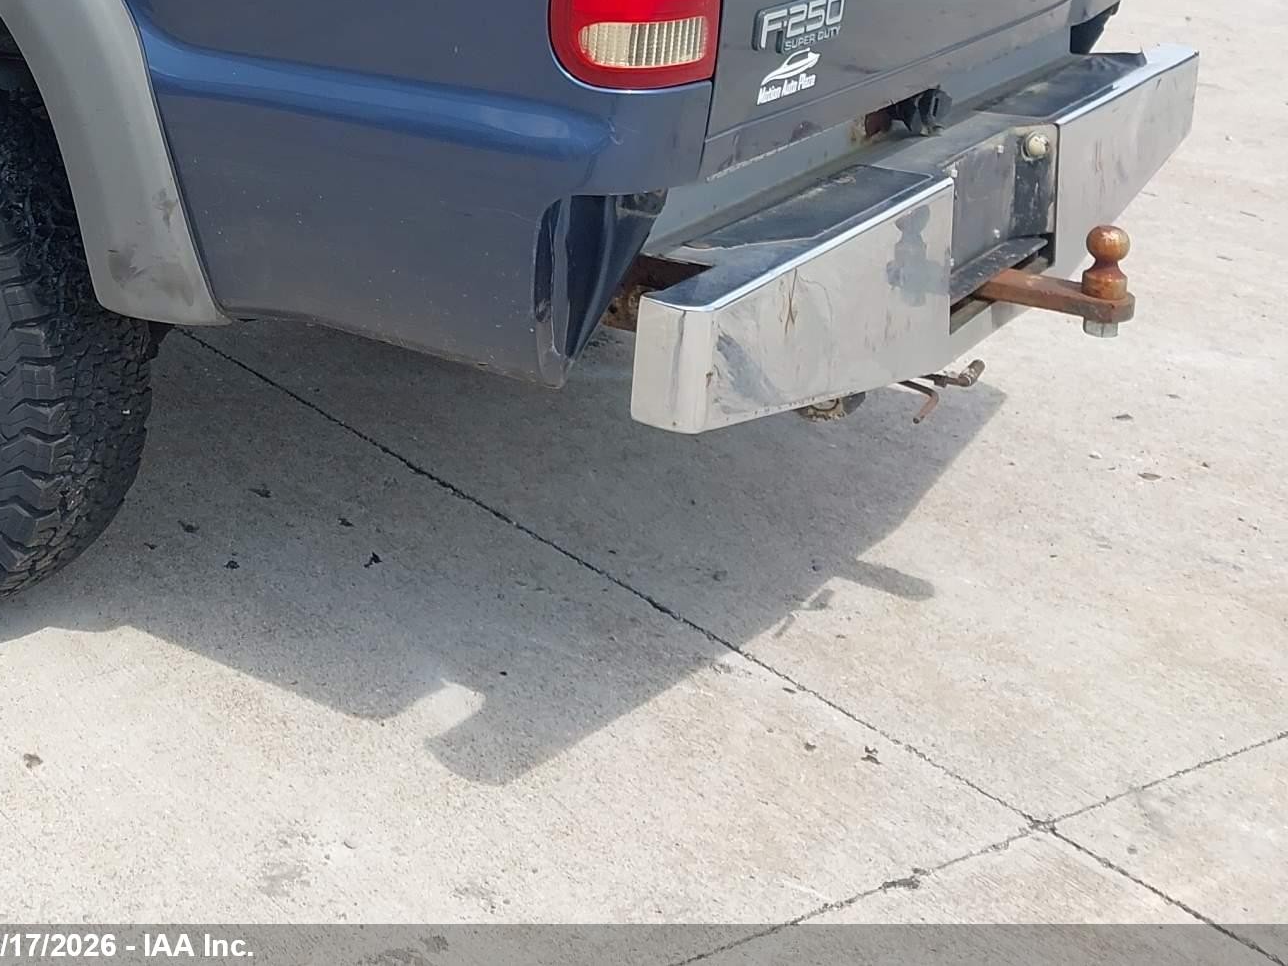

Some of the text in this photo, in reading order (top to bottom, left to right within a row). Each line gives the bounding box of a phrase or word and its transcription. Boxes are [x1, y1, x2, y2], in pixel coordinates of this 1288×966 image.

[784, 25, 841, 51] SUPER DUTY
[781, 79, 798, 97] Auto
